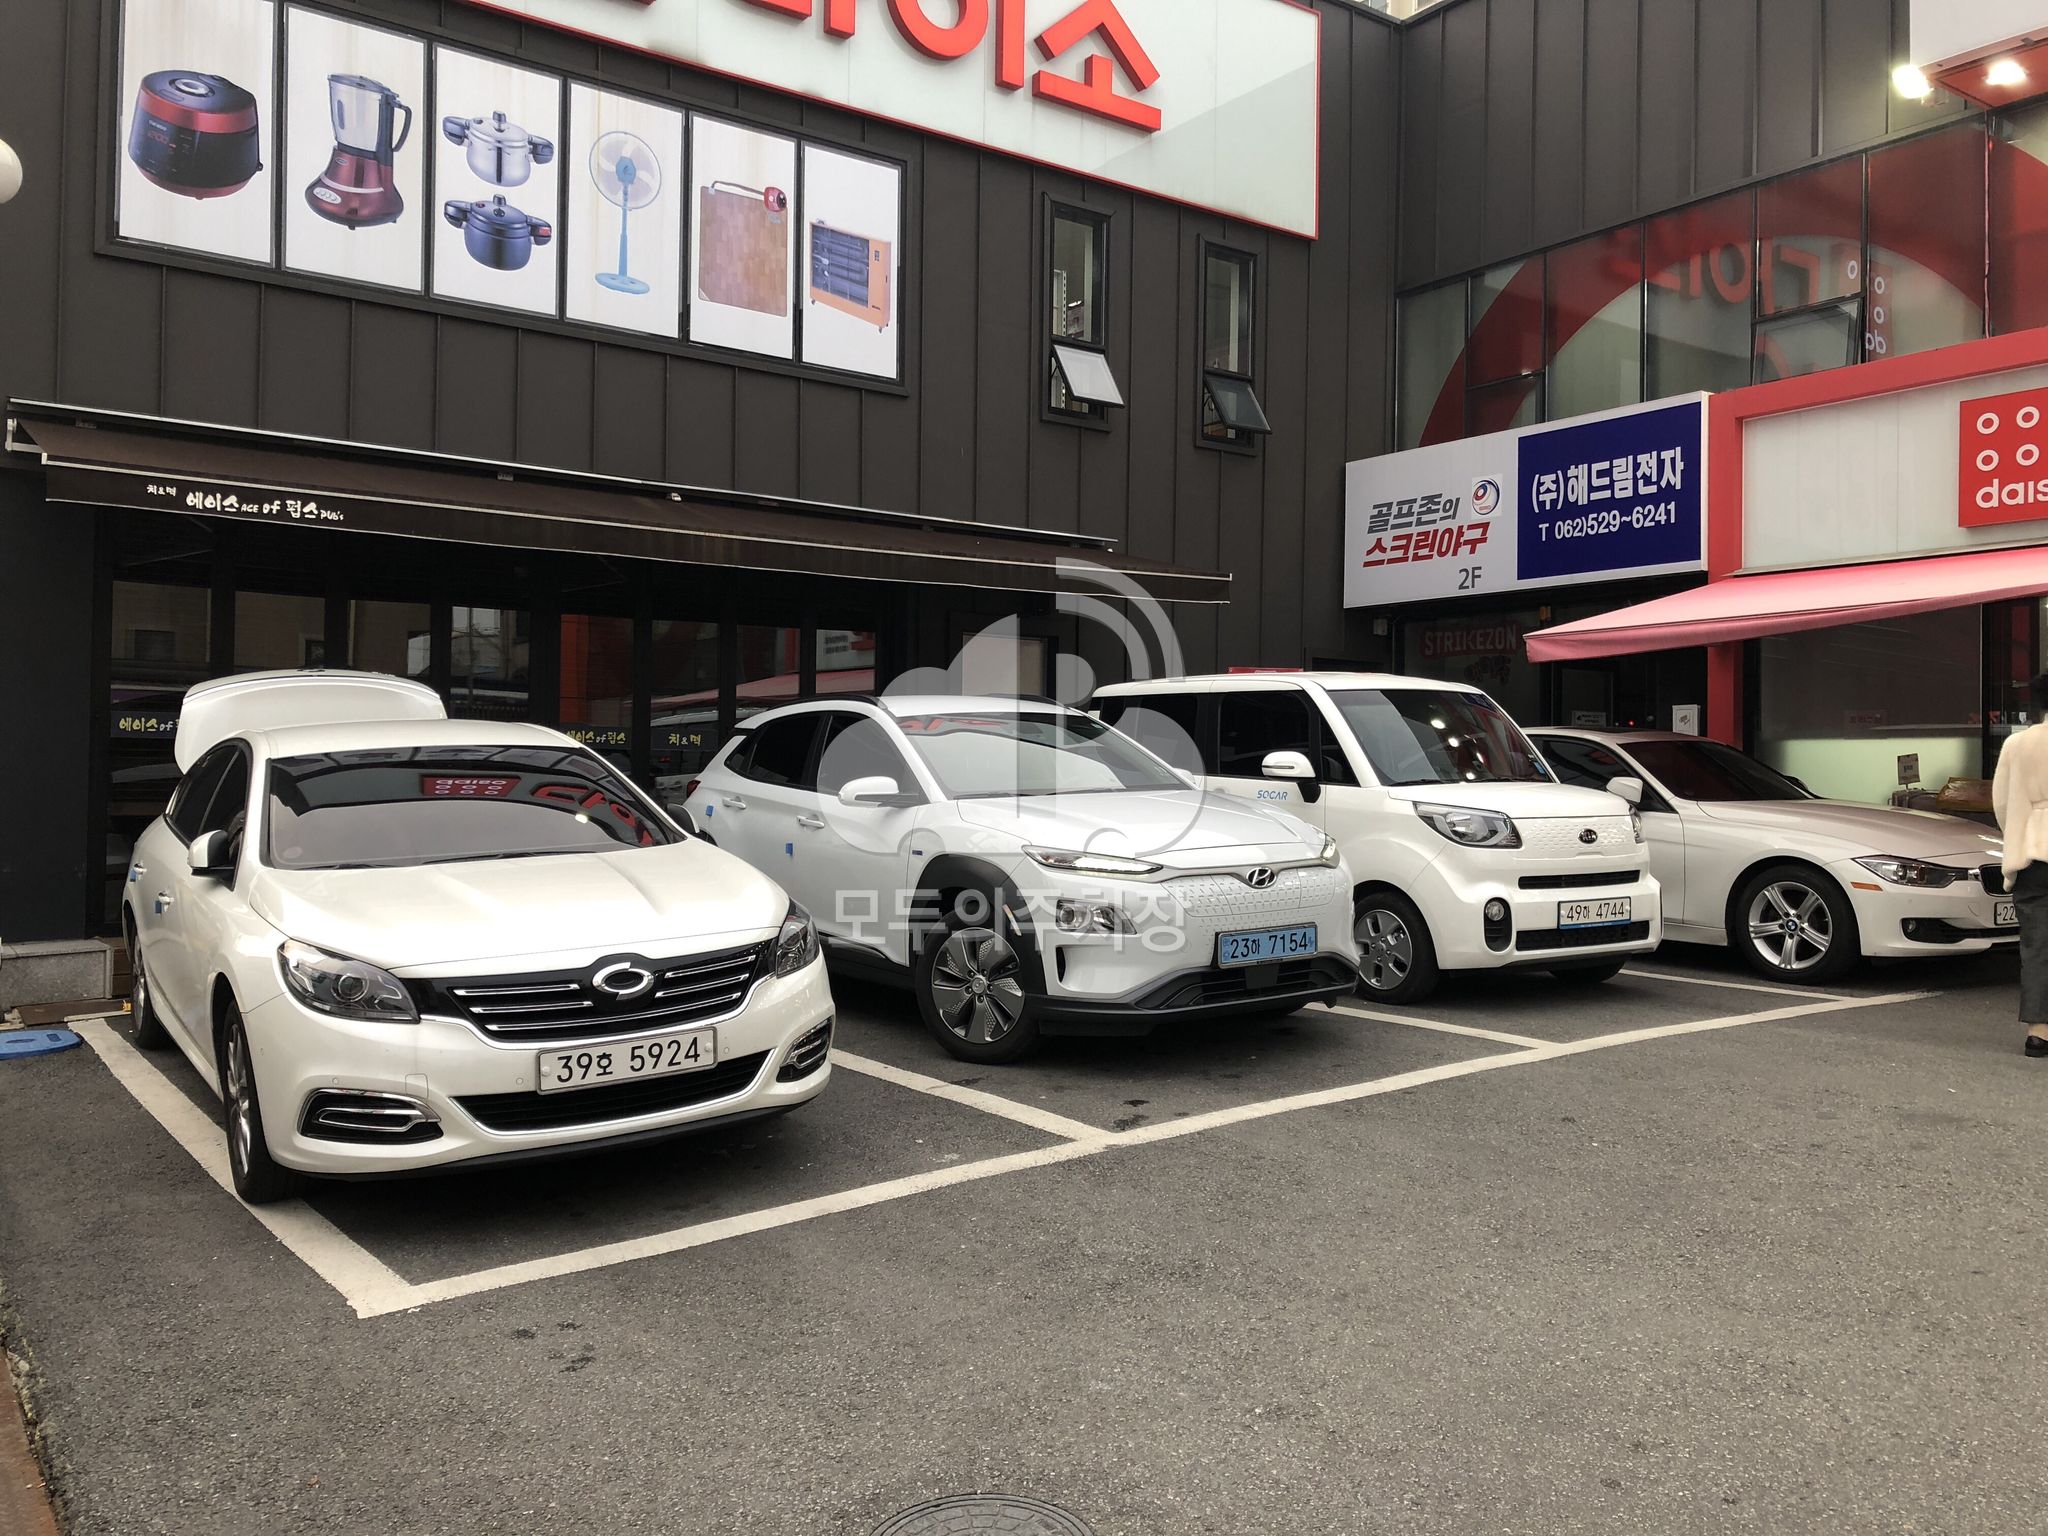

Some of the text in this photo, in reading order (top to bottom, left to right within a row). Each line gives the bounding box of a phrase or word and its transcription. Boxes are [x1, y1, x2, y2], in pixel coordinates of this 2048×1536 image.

[738, 0, 1160, 133] 이소
[1532, 446, 1685, 513] (주)해드림전자
[186, 491, 239, 512] 에이스
[1367, 493, 1461, 535] 골프존의
[1363, 521, 1491, 568] 스크린야구
[1539, 523, 1550, 542] T
[1458, 566, 1482, 590] 2F
[118, 717, 158, 732] 에이스
[1257, 789, 1288, 801] SOCAR
[1567, 901, 1625, 922] 49하 4744
[1230, 931, 1308, 959] 23하 7154
[556, 1036, 701, 1083] 39호 5924
